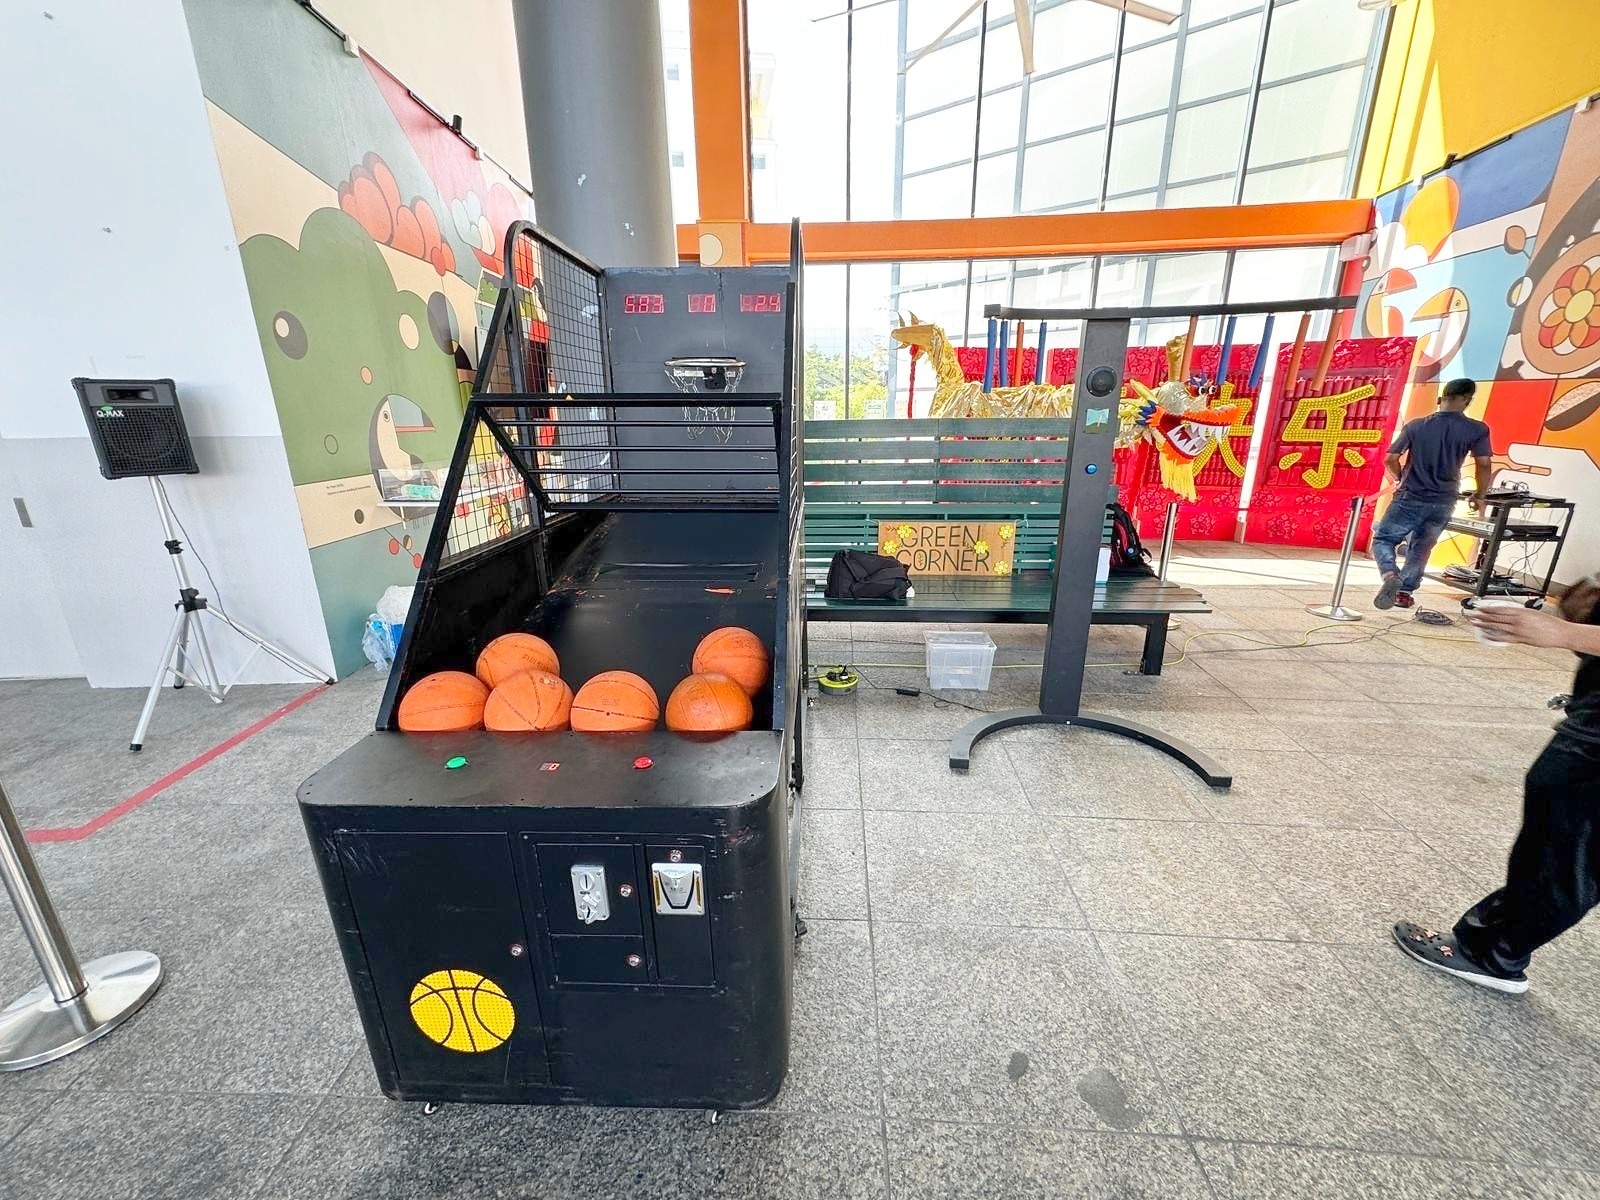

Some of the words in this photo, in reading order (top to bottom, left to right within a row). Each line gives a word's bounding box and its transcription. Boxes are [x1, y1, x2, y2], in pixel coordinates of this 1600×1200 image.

[625, 294, 663, 314] 583
[96, 409, 125, 418] Q-MAX
[900, 525, 982, 549] GREEN
[895, 548, 991, 572] CORNER
